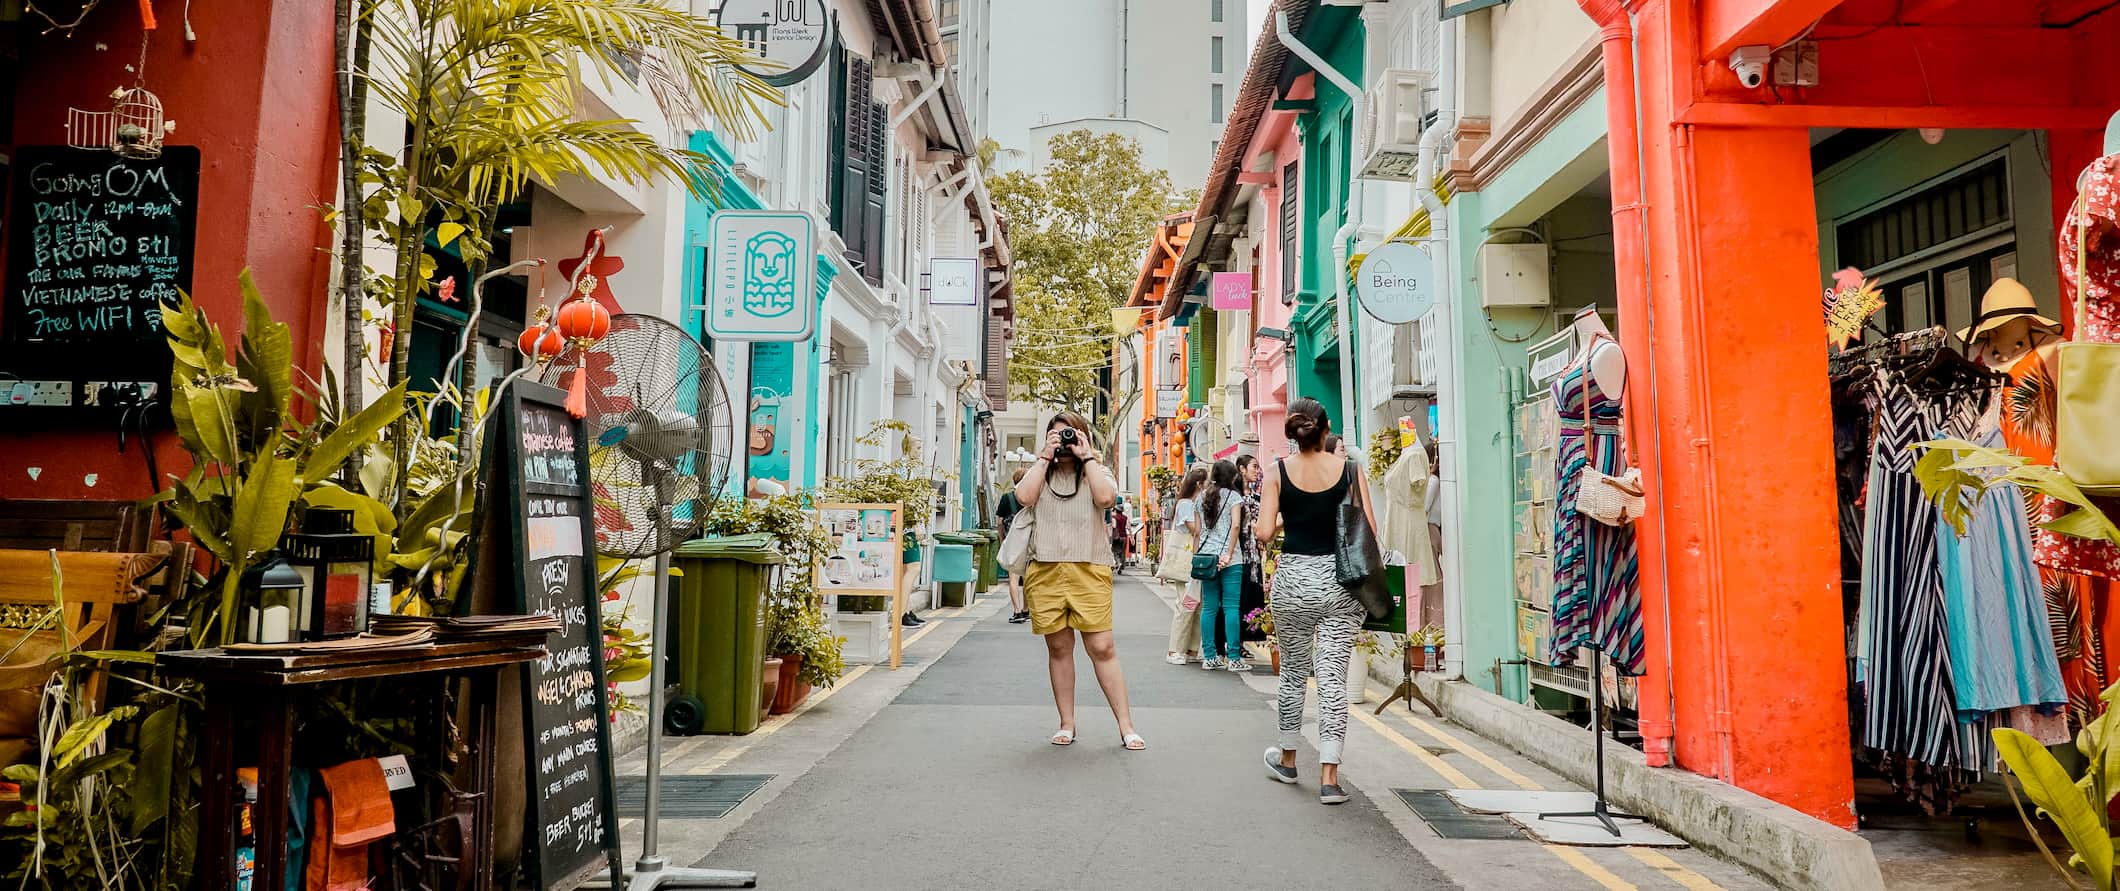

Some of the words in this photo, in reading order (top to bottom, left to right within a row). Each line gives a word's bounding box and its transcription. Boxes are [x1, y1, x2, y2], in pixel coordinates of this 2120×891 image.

[30, 162, 101, 197] Going
[33, 198, 94, 226] Daily
[32, 220, 113, 246] BEER
[34, 236, 128, 267] PROMO
[22, 283, 133, 307] VIETNAMESE
[139, 282, 177, 301] coffee
[1373, 274, 1416, 291] Being
[1374, 290, 1425, 304] Centre
[28, 308, 72, 336] Free
[78, 305, 132, 332] WIFI
[556, 645, 591, 672] SIGNATURE
[545, 815, 572, 846] BEER
